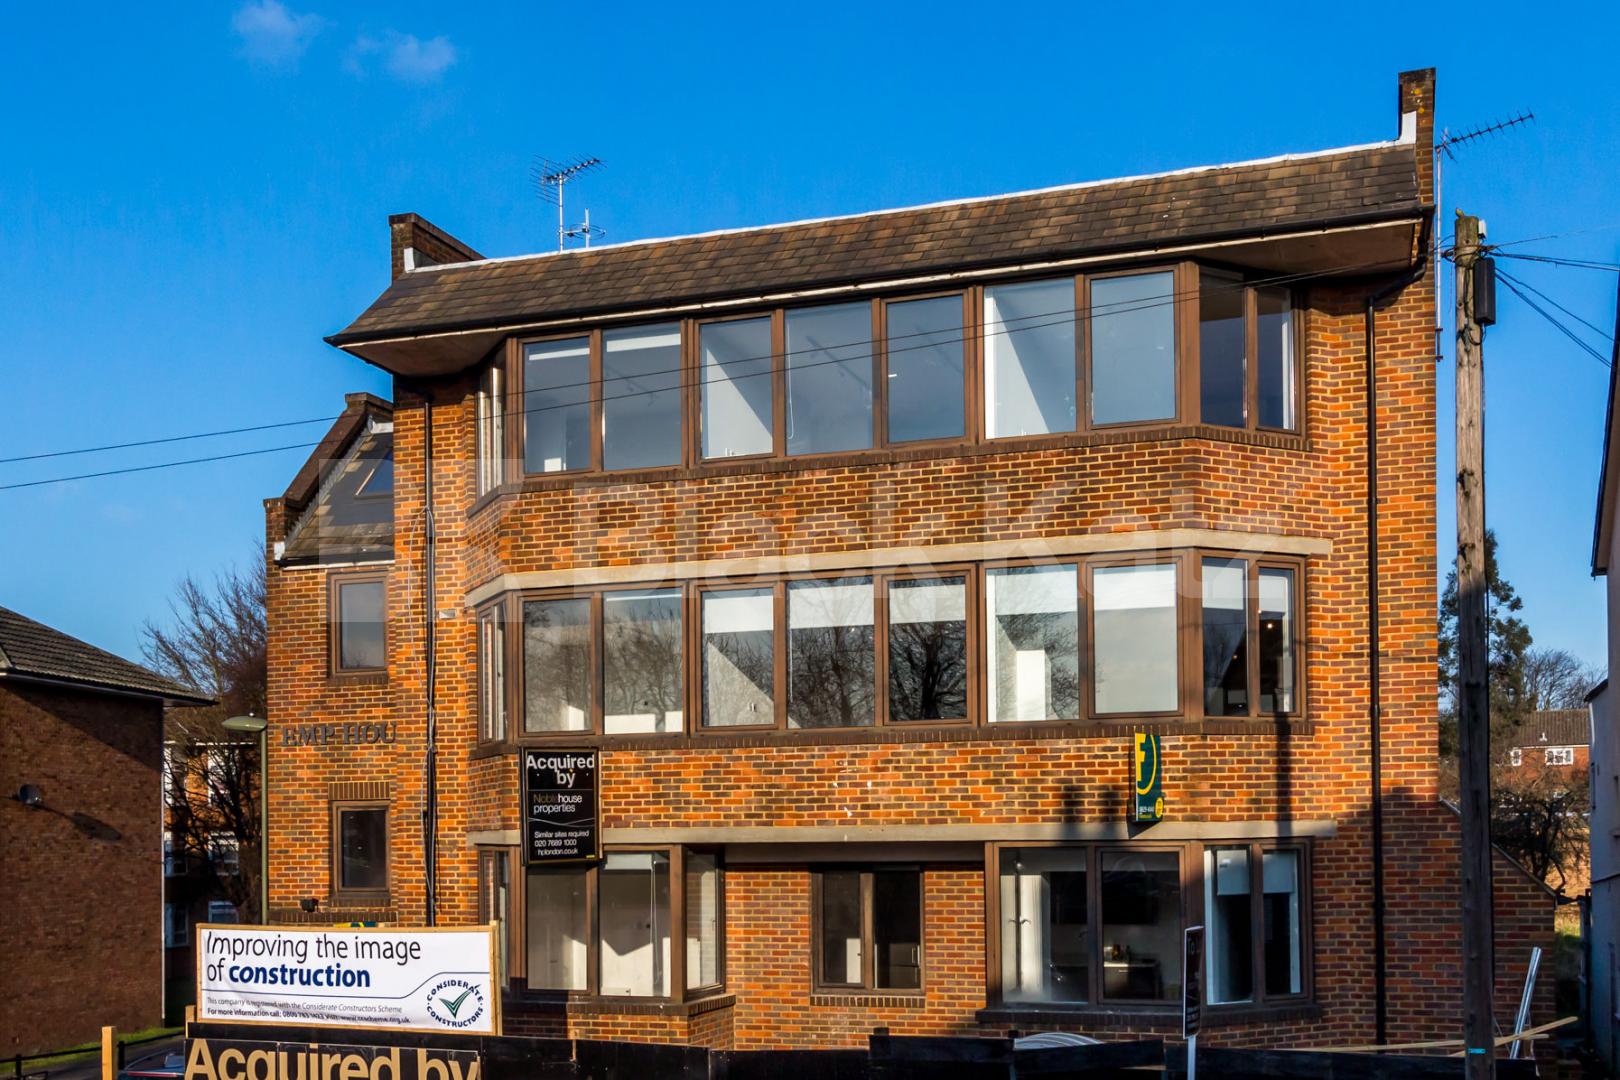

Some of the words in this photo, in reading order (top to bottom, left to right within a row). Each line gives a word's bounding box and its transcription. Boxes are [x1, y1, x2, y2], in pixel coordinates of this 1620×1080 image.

[526, 755, 594, 772] Acquired
[557, 770, 575, 788] by
[558, 793, 582, 803] house
[534, 804, 576, 815] properties
[206, 931, 308, 964] Improving
[316, 933, 348, 959] the
[355, 936, 421, 966] image
[207, 958, 226, 982] of
[229, 962, 370, 988] construction
[426, 980, 484, 1002] CONSIDERATE
[302, 1002, 338, 1011] Considerate
[338, 1004, 376, 1012] Constructors
[378, 1004, 402, 1013] Scheme
[426, 1006, 484, 1028] CONSTRUCTORS
[184, 1038, 400, 1080] Acquired
[418, 1048, 480, 1080] by
